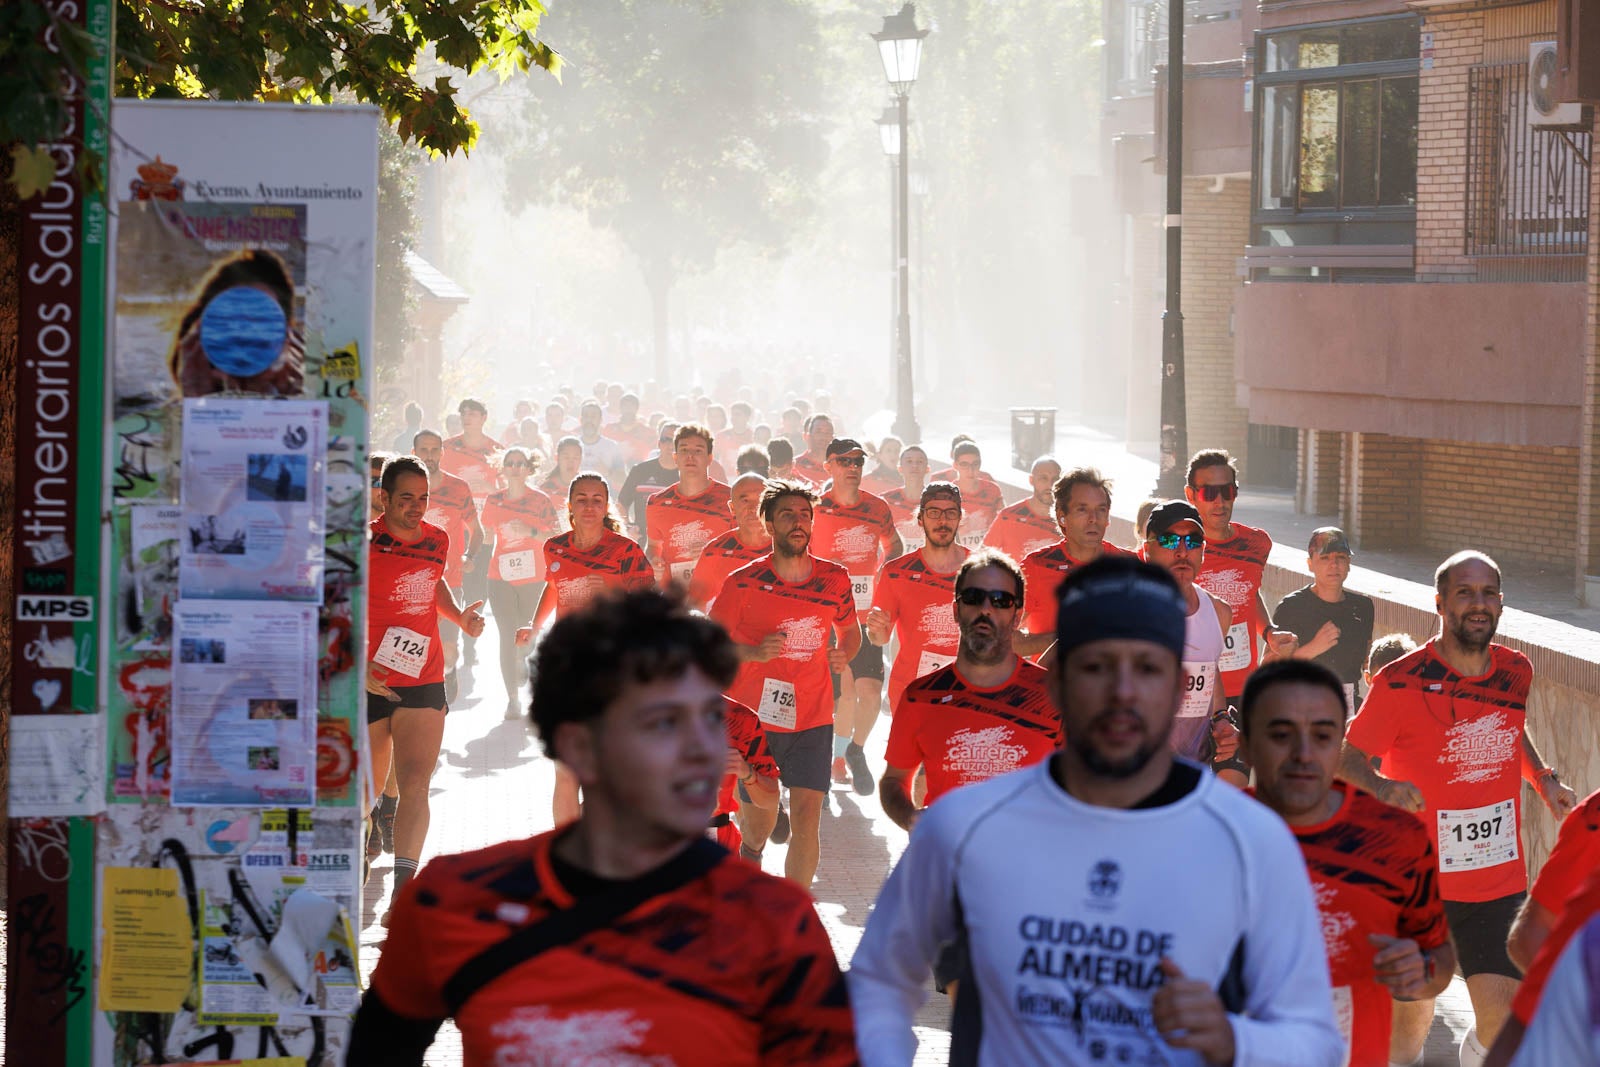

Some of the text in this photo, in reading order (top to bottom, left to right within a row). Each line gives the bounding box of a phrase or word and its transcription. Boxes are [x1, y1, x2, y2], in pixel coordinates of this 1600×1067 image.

[255, 182, 363, 202] Ayuntamiento
[683, 569, 694, 580] 6
[21, 600, 89, 617] MPS
[922, 613, 954, 625] carre
[786, 629, 823, 640] arrera
[393, 635, 424, 658] 1124
[772, 689, 796, 707] 152
[1448, 732, 1514, 751] carrera
[948, 745, 1020, 762] carrera
[1447, 748, 1513, 763] cruzroja.es
[1452, 816, 1502, 842] 1397
[246, 854, 284, 867] OFERTA
[1018, 914, 1129, 952] CIUDAD
